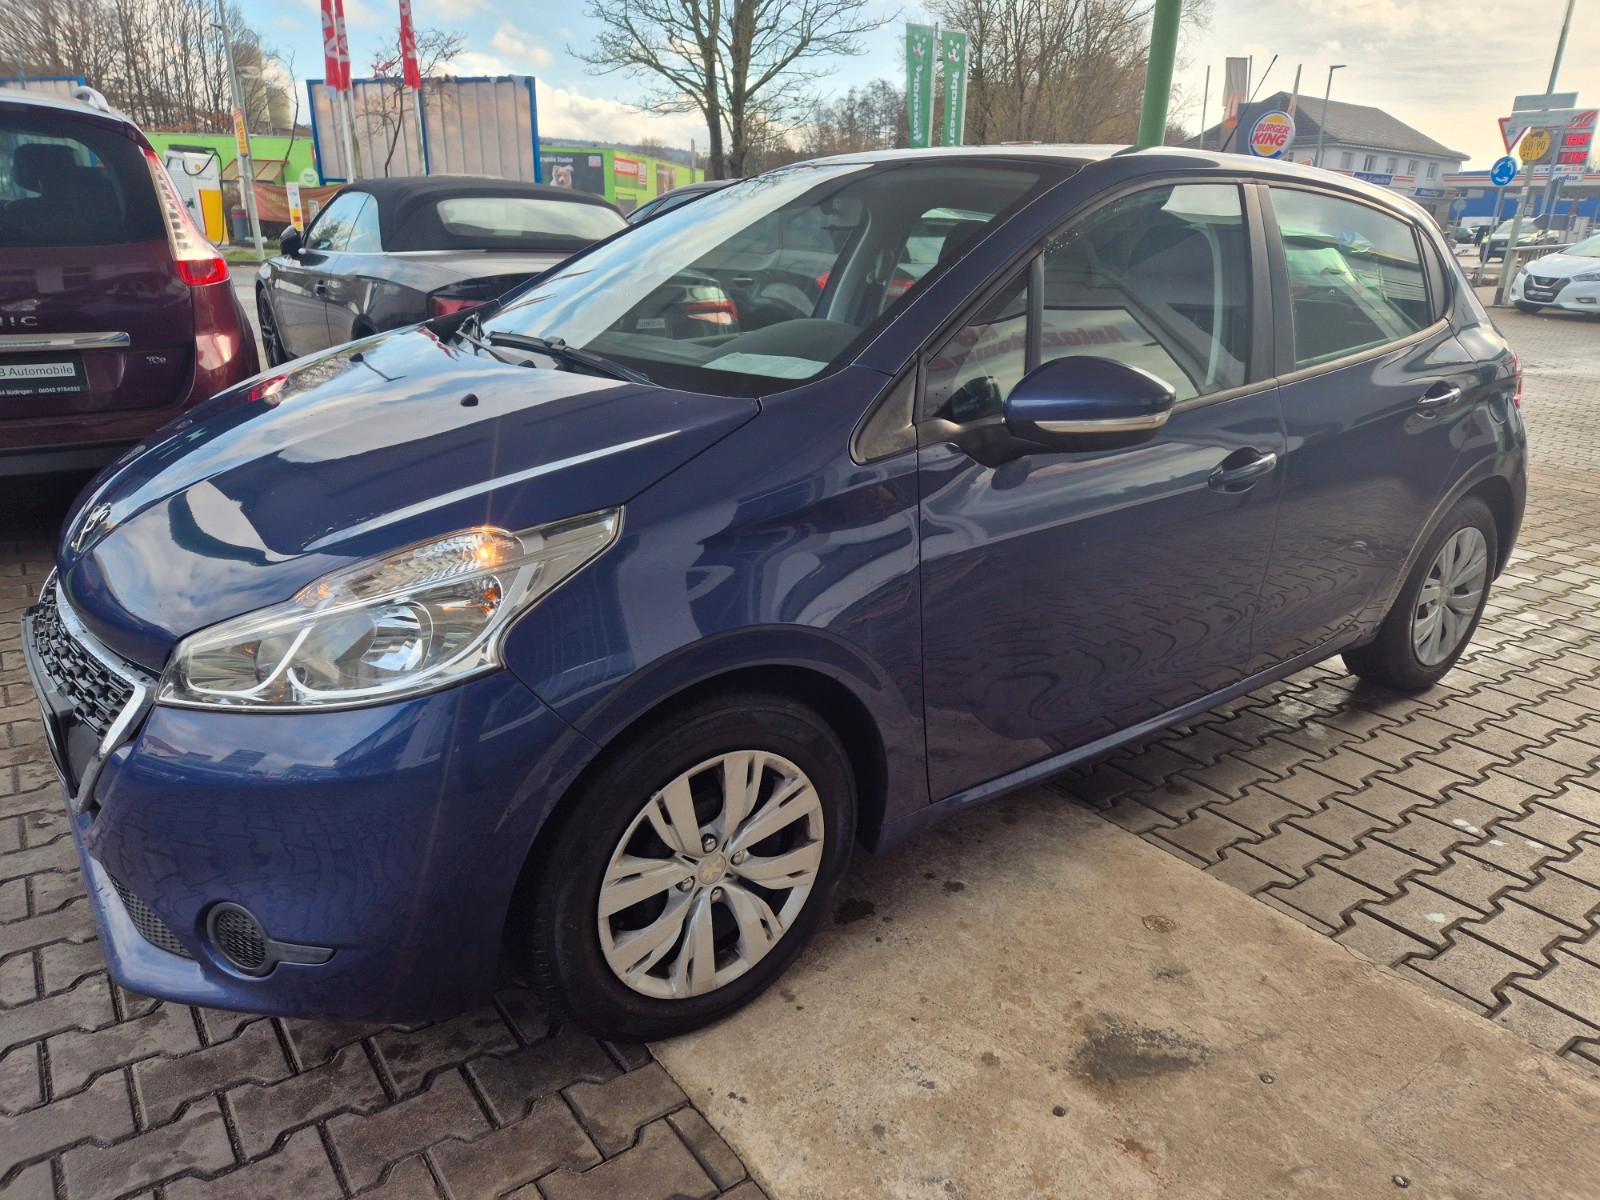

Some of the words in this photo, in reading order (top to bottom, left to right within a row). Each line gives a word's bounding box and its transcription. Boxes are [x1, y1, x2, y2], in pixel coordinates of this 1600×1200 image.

[1256, 124, 1290, 135] BURGER
[1251, 133, 1287, 147] KING
[8, 365, 73, 377] Automobile
